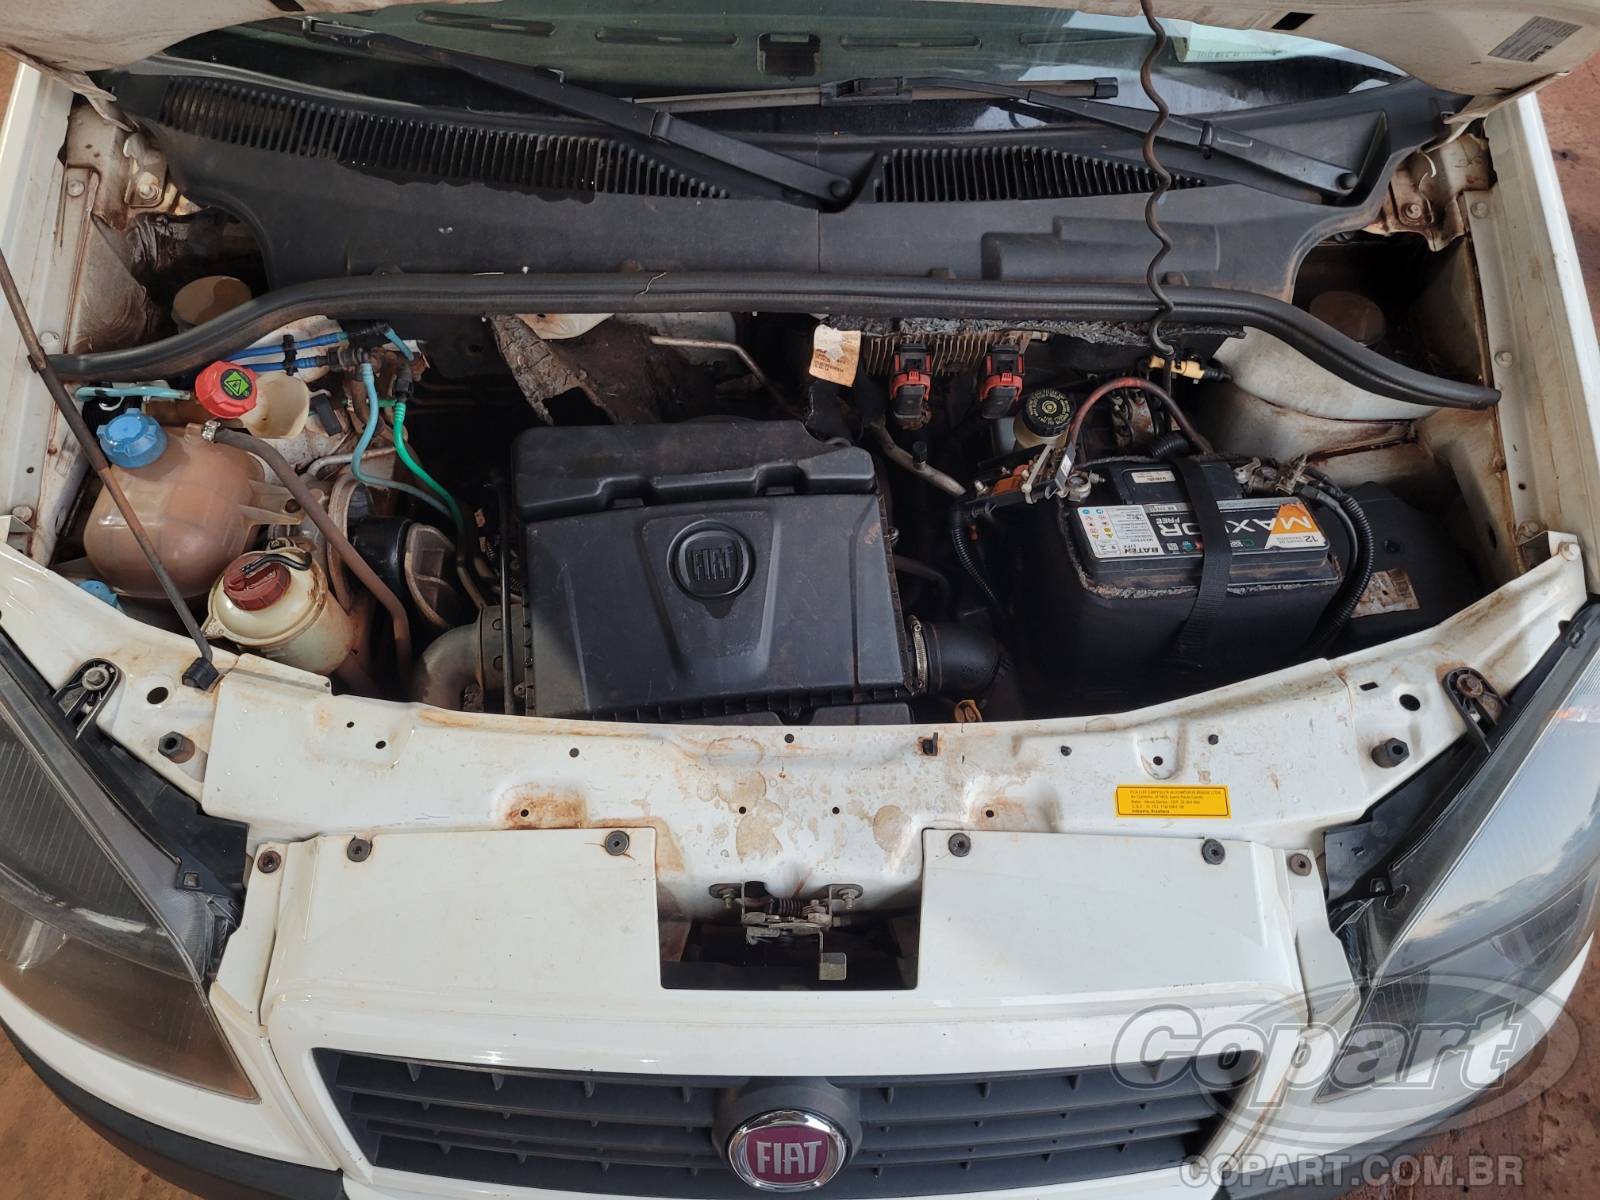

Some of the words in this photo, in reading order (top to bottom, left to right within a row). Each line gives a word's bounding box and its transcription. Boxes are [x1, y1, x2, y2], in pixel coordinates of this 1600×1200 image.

[1303, 535, 1318, 543] 12
[690, 545, 735, 581] FIAT
[756, 1140, 822, 1174] FIAT
